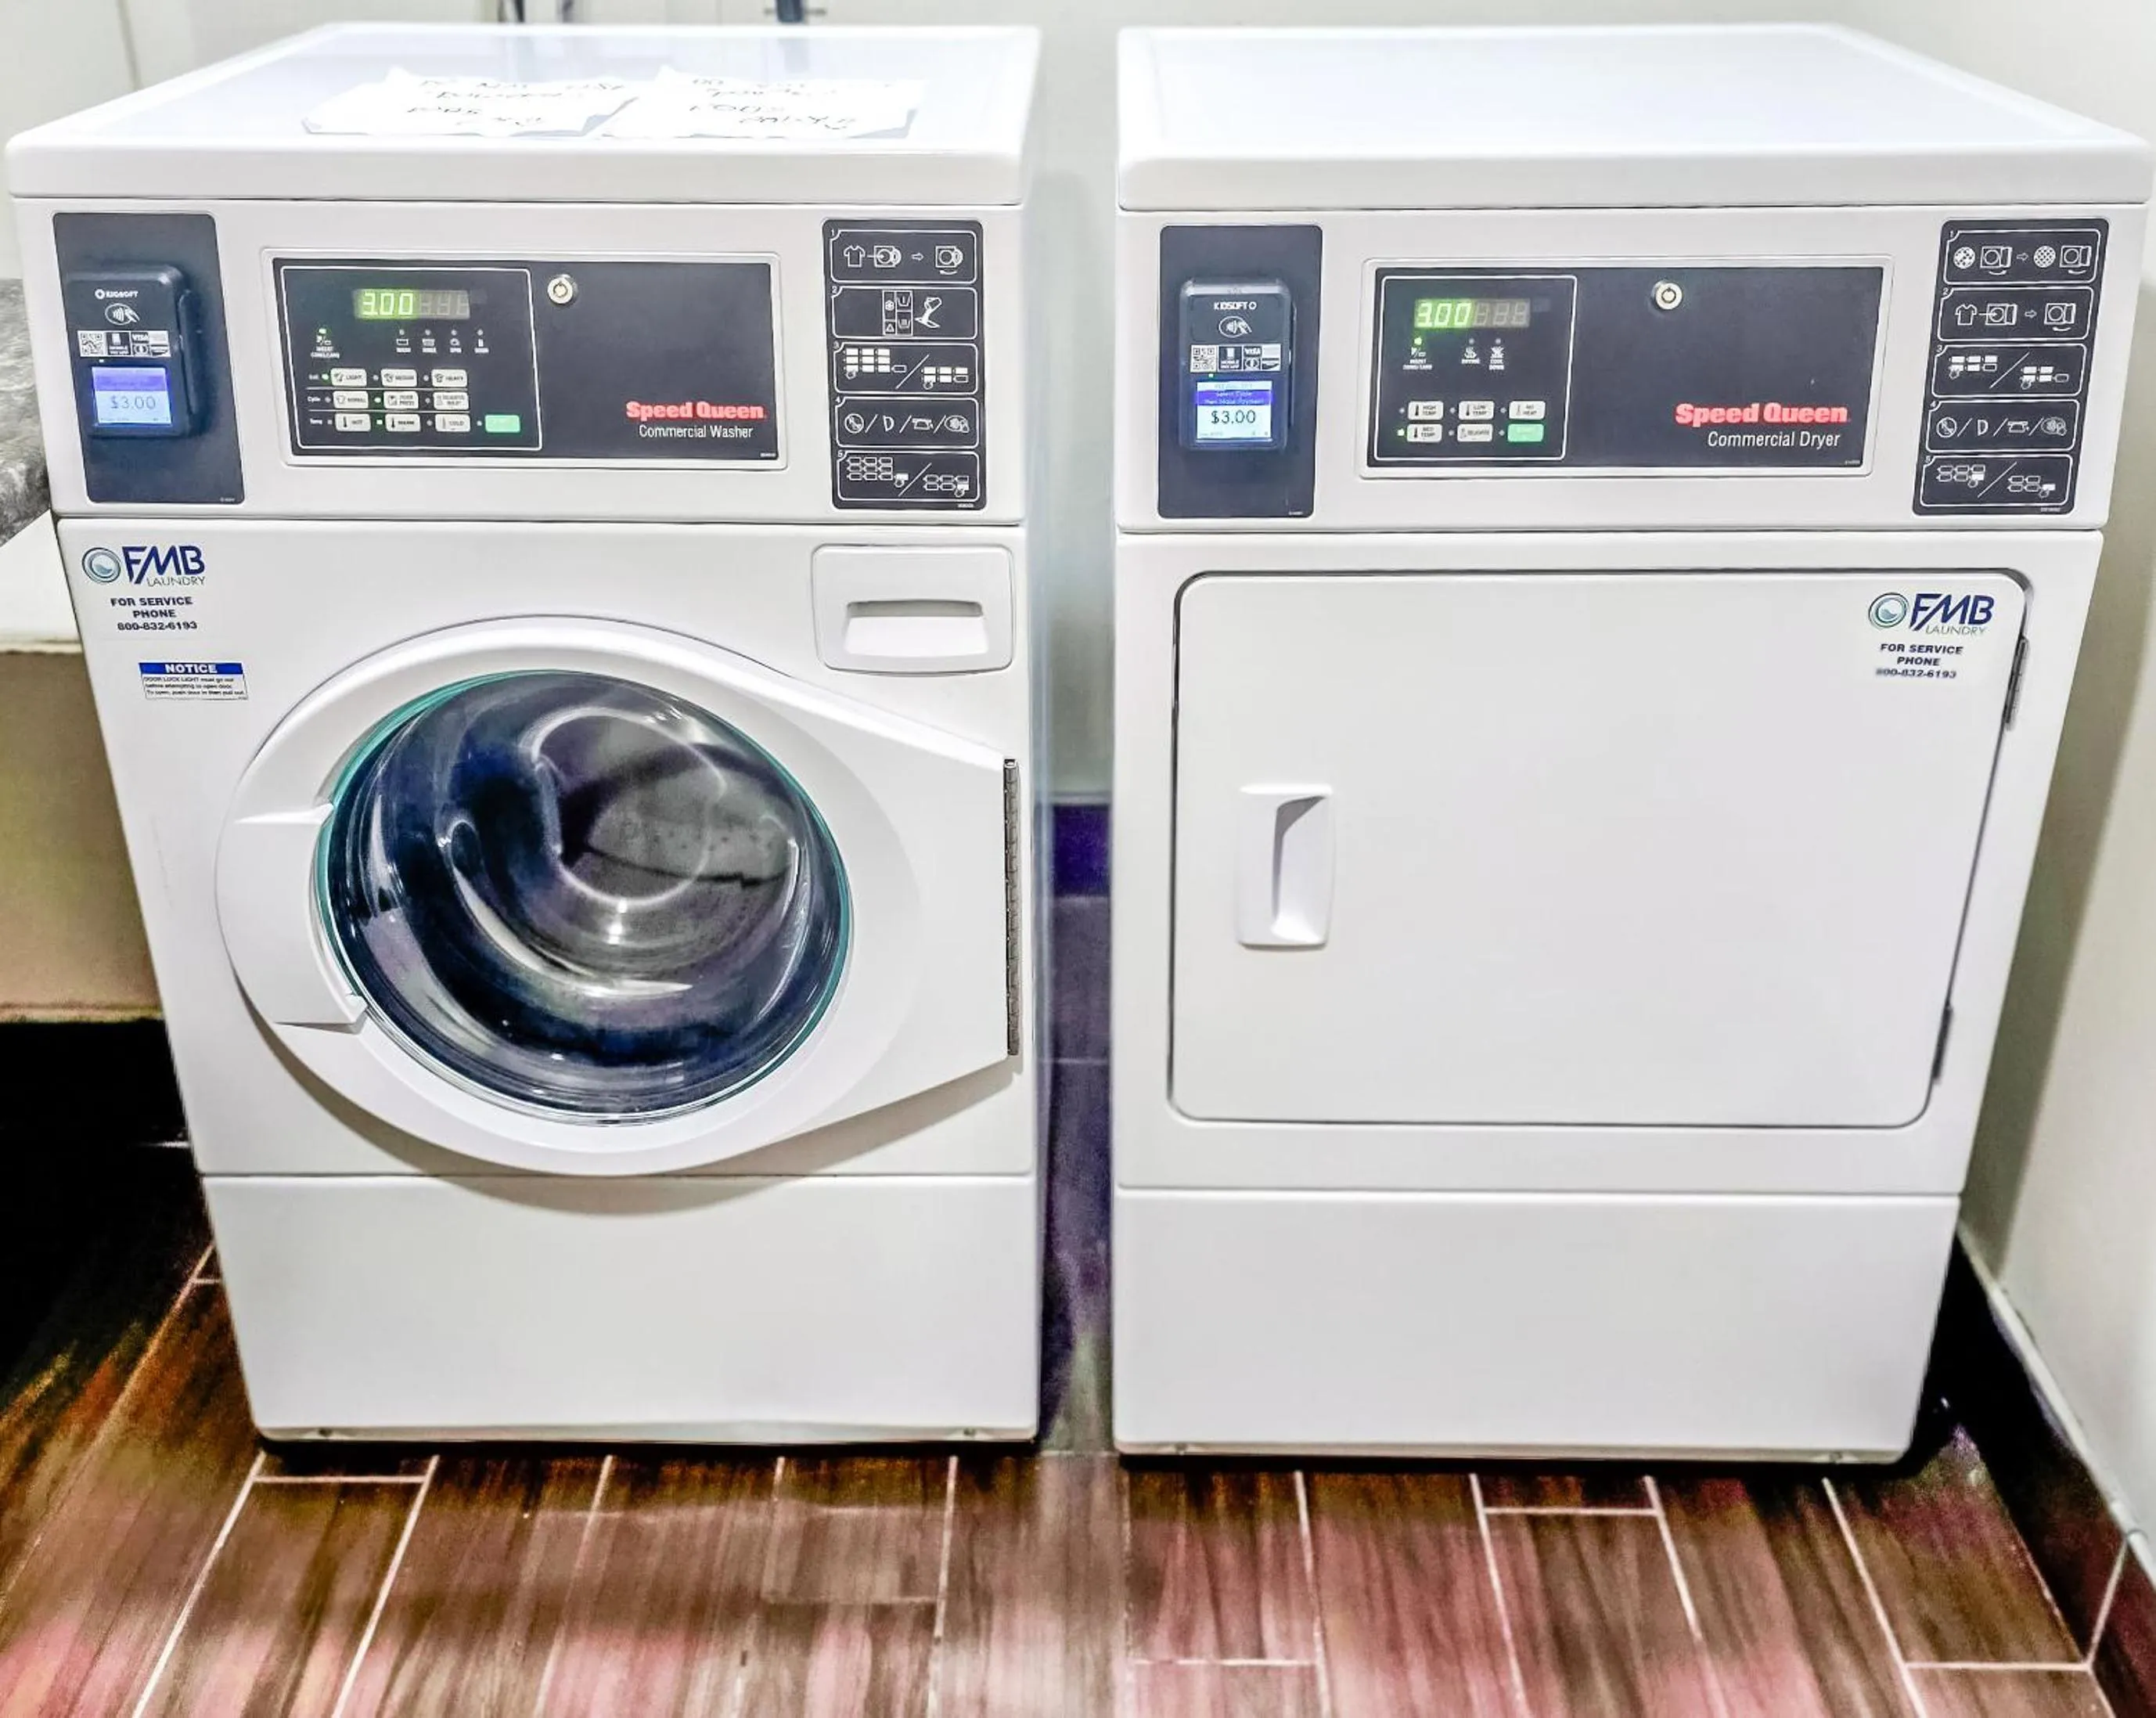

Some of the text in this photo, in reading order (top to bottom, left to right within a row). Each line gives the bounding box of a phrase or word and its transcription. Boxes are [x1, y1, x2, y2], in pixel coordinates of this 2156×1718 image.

[362, 292, 414, 316] 3.00
[1416, 302, 1472, 327] 3.00
[110, 395, 157, 409] $3.00
[626, 401, 765, 421] Speed Queen
[1211, 409, 1256, 424] $3.00
[1675, 402, 1848, 427] Speed Queen
[639, 424, 753, 438] Commercial Washer
[1708, 431, 1841, 449] Commercial Dryer
[122, 546, 205, 585] FMB
[146, 575, 206, 587] LAUNDRY
[110, 596, 194, 607] FOR SERVICE
[132, 609, 177, 619] PHONE
[1909, 593, 1994, 632] FMB
[117, 621, 198, 631] 800-832-6193
[1925, 625, 1989, 636] LAUNDRY
[1880, 643, 1963, 655] FOR SERVICE
[164, 664, 218, 673] NOTICE
[1896, 656, 1942, 667] PHONE
